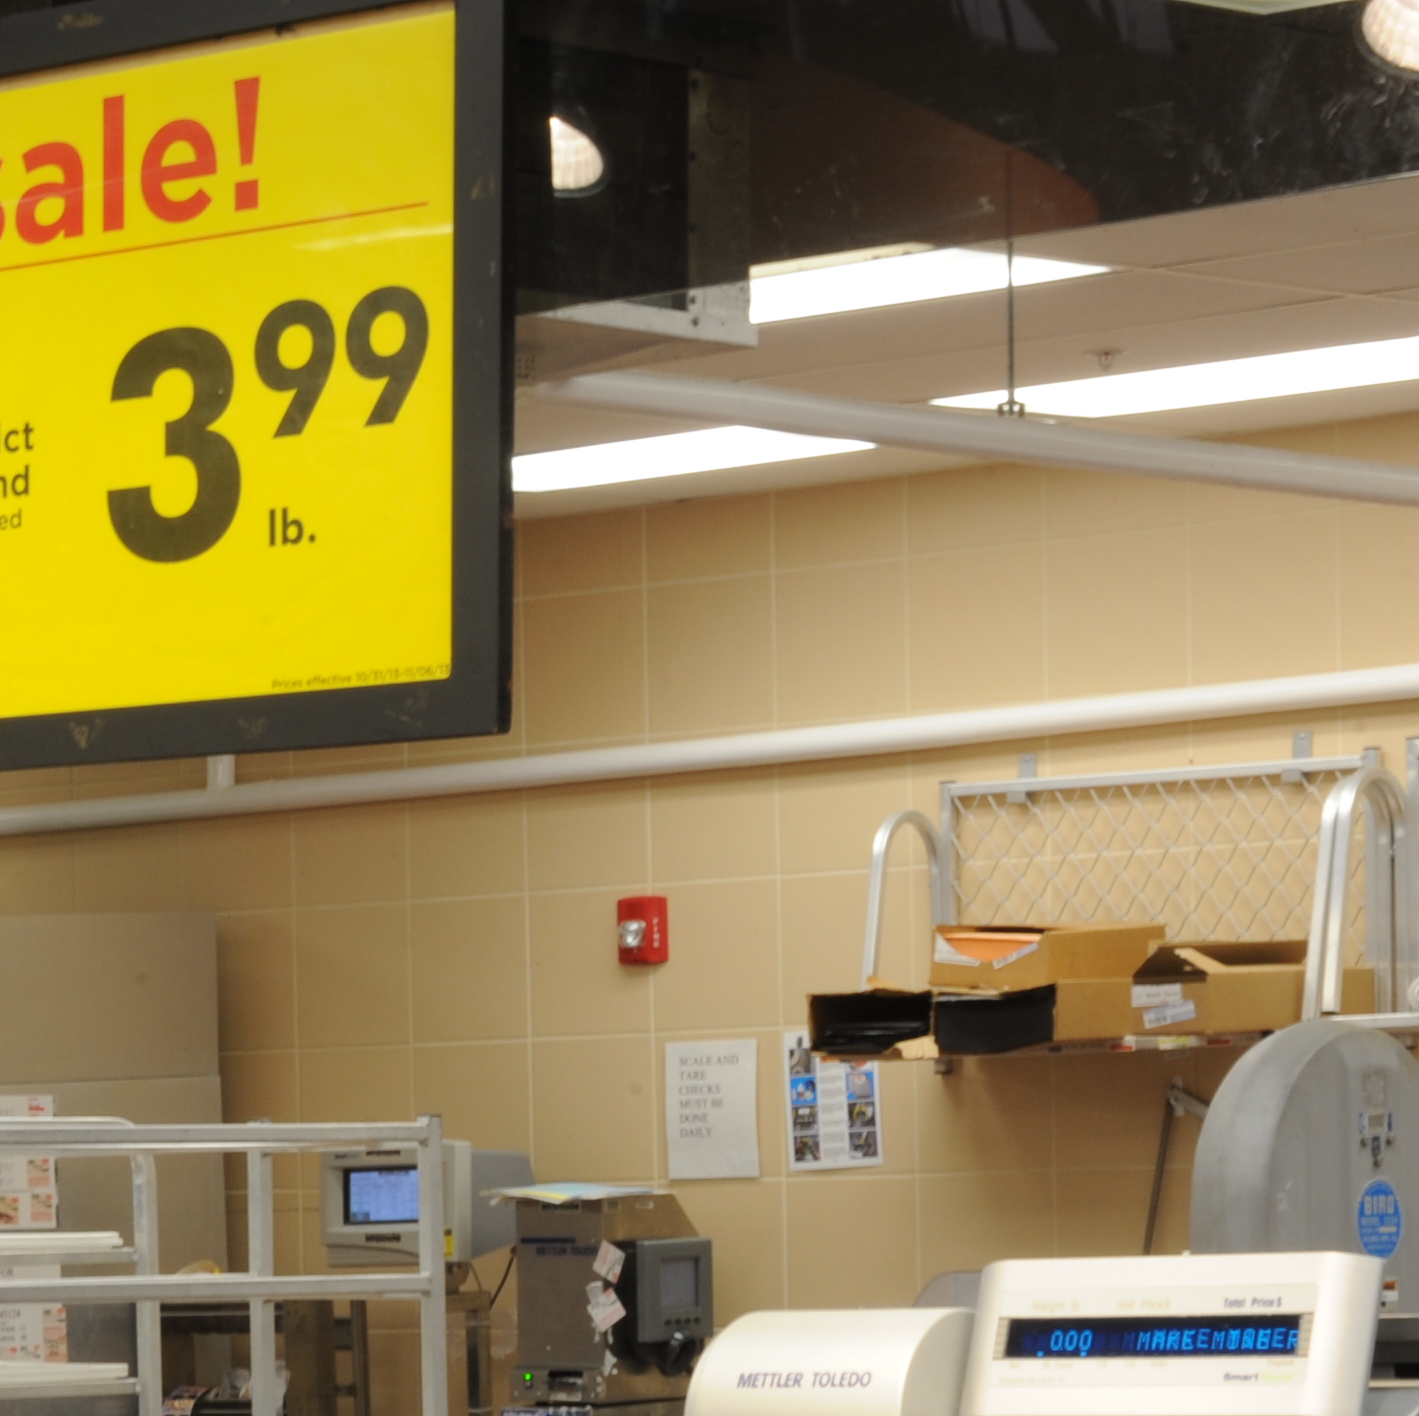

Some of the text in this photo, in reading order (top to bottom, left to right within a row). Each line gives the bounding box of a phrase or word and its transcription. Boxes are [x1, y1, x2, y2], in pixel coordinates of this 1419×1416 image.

[266, 509, 318, 548] lb.
[678, 1054, 739, 1068] SCALE AND
[679, 1070, 707, 1081] TARE
[678, 1083, 721, 1096] CHECKS
[679, 1099, 709, 1111] MUST
[679, 1113, 708, 1125] DONE
[679, 1127, 713, 1139] DAILY
[737, 1372, 872, 1389] METTLER TOLEDO
